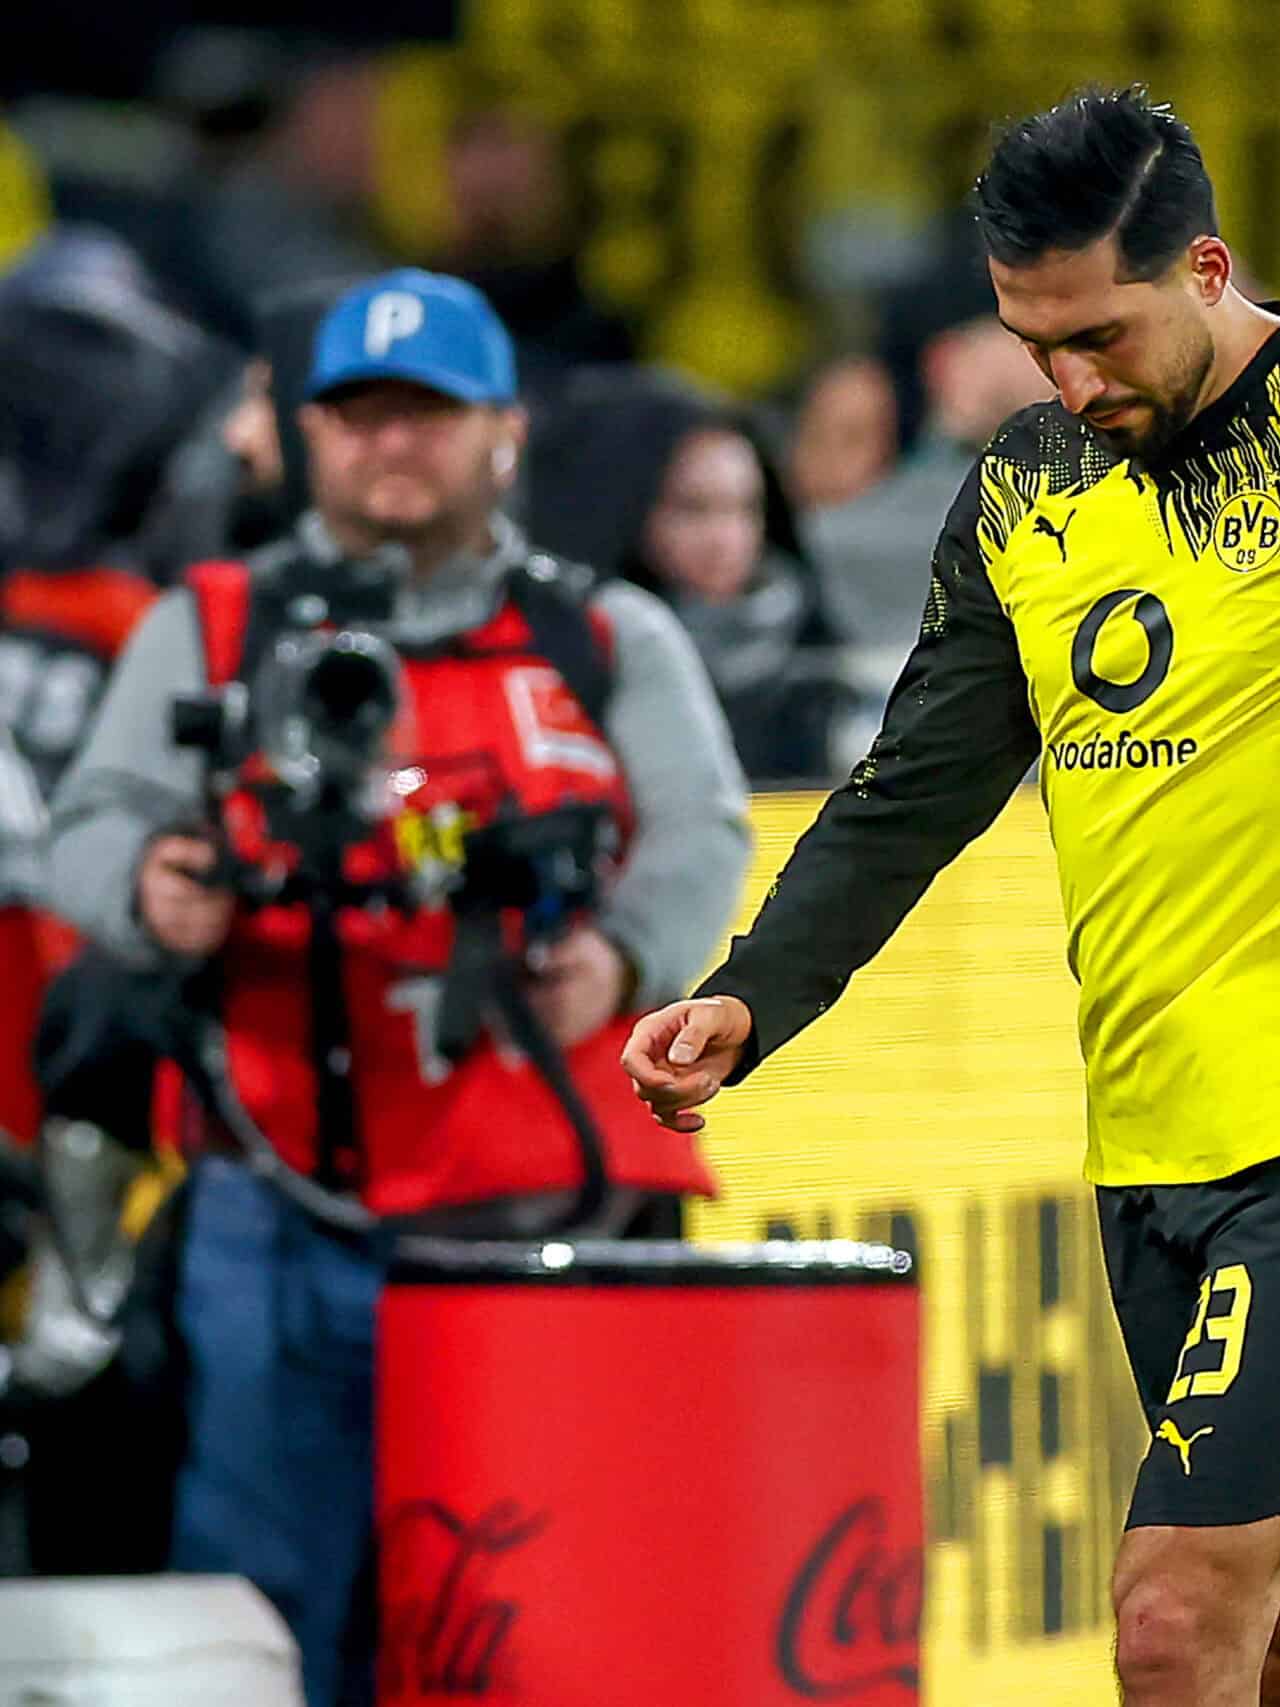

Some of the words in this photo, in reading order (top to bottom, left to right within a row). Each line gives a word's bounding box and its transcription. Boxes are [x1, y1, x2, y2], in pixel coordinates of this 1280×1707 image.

[365, 289, 424, 357] P
[1222, 499, 1280, 549] BVB
[1235, 548, 1257, 566] 09
[1047, 730, 1198, 772] vodafone
[1166, 1263, 1252, 1406] 23
